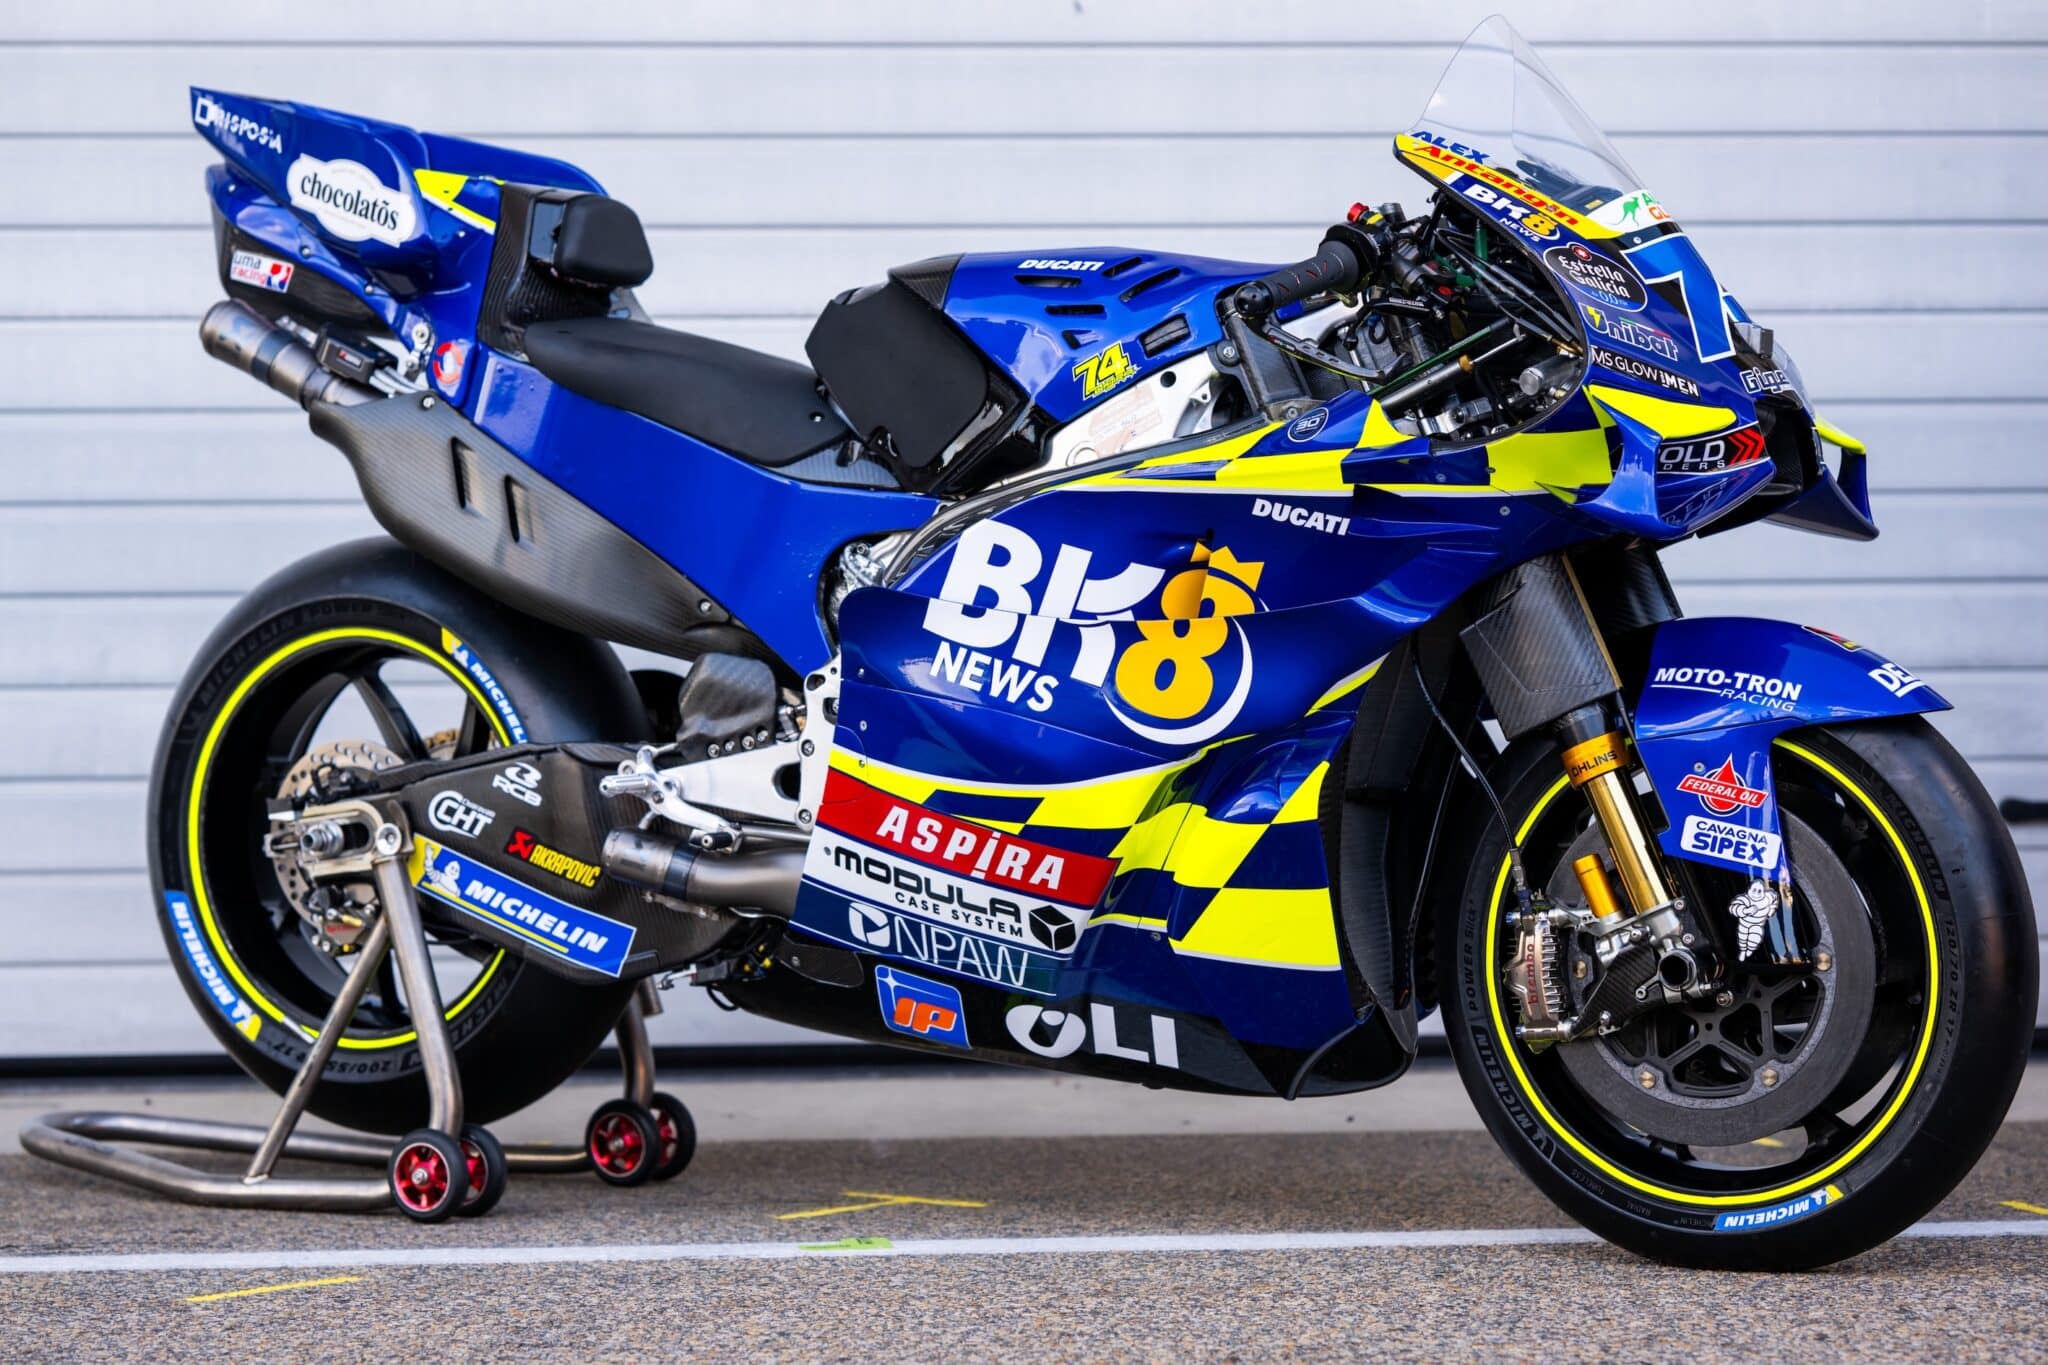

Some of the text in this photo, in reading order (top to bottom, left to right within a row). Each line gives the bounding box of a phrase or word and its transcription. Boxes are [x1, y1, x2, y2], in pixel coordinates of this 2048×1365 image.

[1410, 131, 1490, 165] ALEX
[1414, 145, 1579, 226] Antangin
[1462, 183, 1558, 237] BK8
[1500, 218, 1541, 242] NEWS
[1017, 259, 1105, 271] DUCATI
[1558, 255, 1626, 283] Estrella
[1569, 270, 1631, 298] Galicia
[1578, 302, 1679, 361] Unibat
[1072, 340, 1131, 400] 74
[1592, 349, 1613, 367] MS
[1615, 357, 1658, 381] GLOW
[1658, 439, 1726, 464] OLD
[1662, 459, 1726, 471] DERS
[1252, 498, 1351, 536] DUCATI
[922, 518, 1257, 719] BK8
[929, 640, 1059, 713] NEWS
[1654, 667, 1803, 701] MOTO-TRON
[470, 662, 528, 744] MICHEL
[1719, 688, 1797, 713] RACING
[492, 774, 542, 807] RCB
[1684, 778, 1759, 804] FEDERAL OIL
[876, 805, 1065, 890] ASPIRA
[1692, 832, 1767, 864] SIPEX
[1696, 820, 1768, 845] CAVAGNA
[834, 846, 1022, 924] MODULA
[464, 879, 609, 953] MICHELIN
[895, 891, 1023, 938] CASE SYSTEM
[171, 901, 235, 1006] MICHELIN
[894, 916, 1029, 987] NPAW
[1525, 943, 1538, 1005] brembo
[893, 997, 958, 1033] IP
[1475, 1033, 1533, 1130] MICHELIN
[1724, 1198, 1811, 1228] MICHELIN
